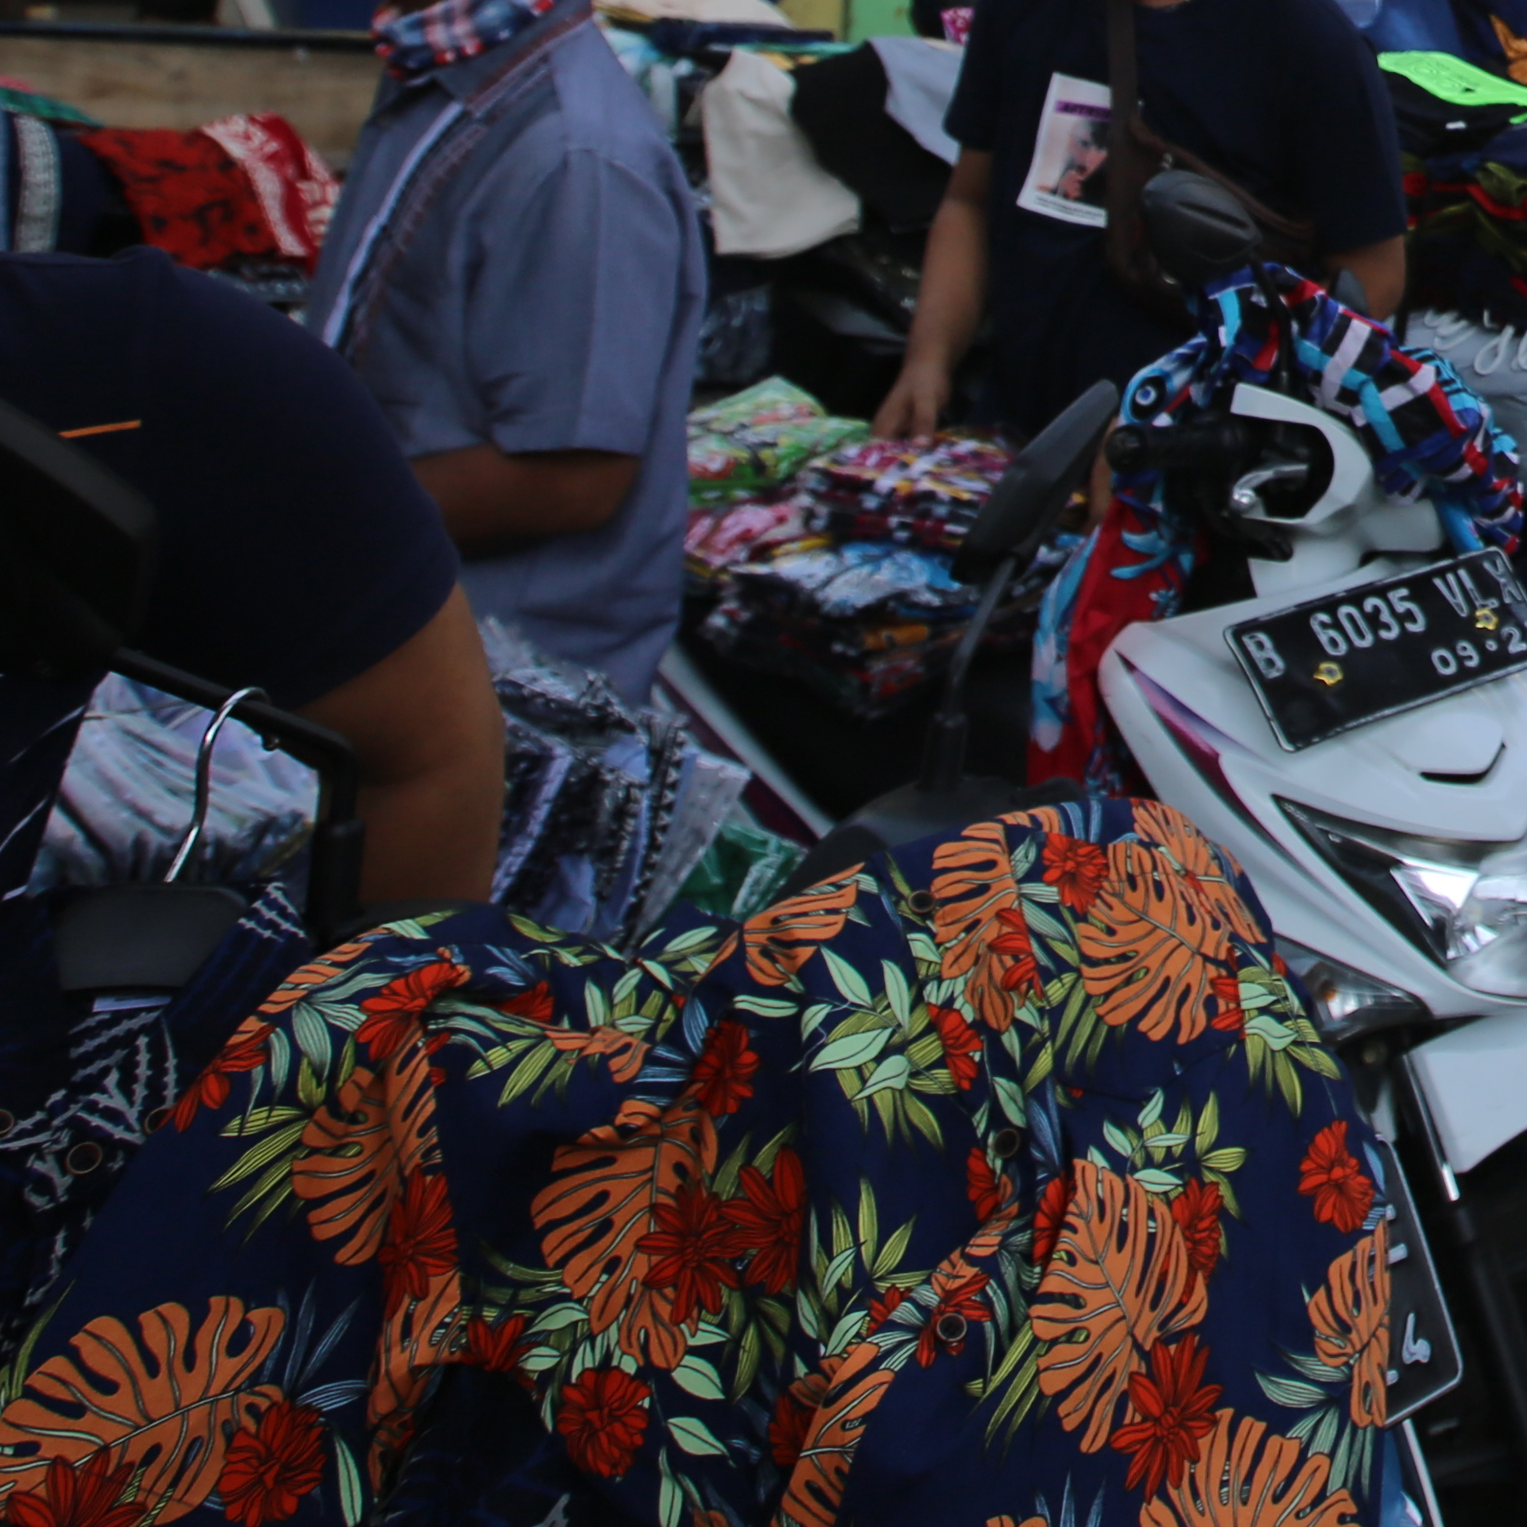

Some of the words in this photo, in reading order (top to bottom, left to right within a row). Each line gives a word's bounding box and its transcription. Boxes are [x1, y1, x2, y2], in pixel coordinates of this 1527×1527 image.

[1241, 631, 1286, 679] B
[1310, 587, 1427, 656] 6035
[1432, 559, 1523, 618] VLX
